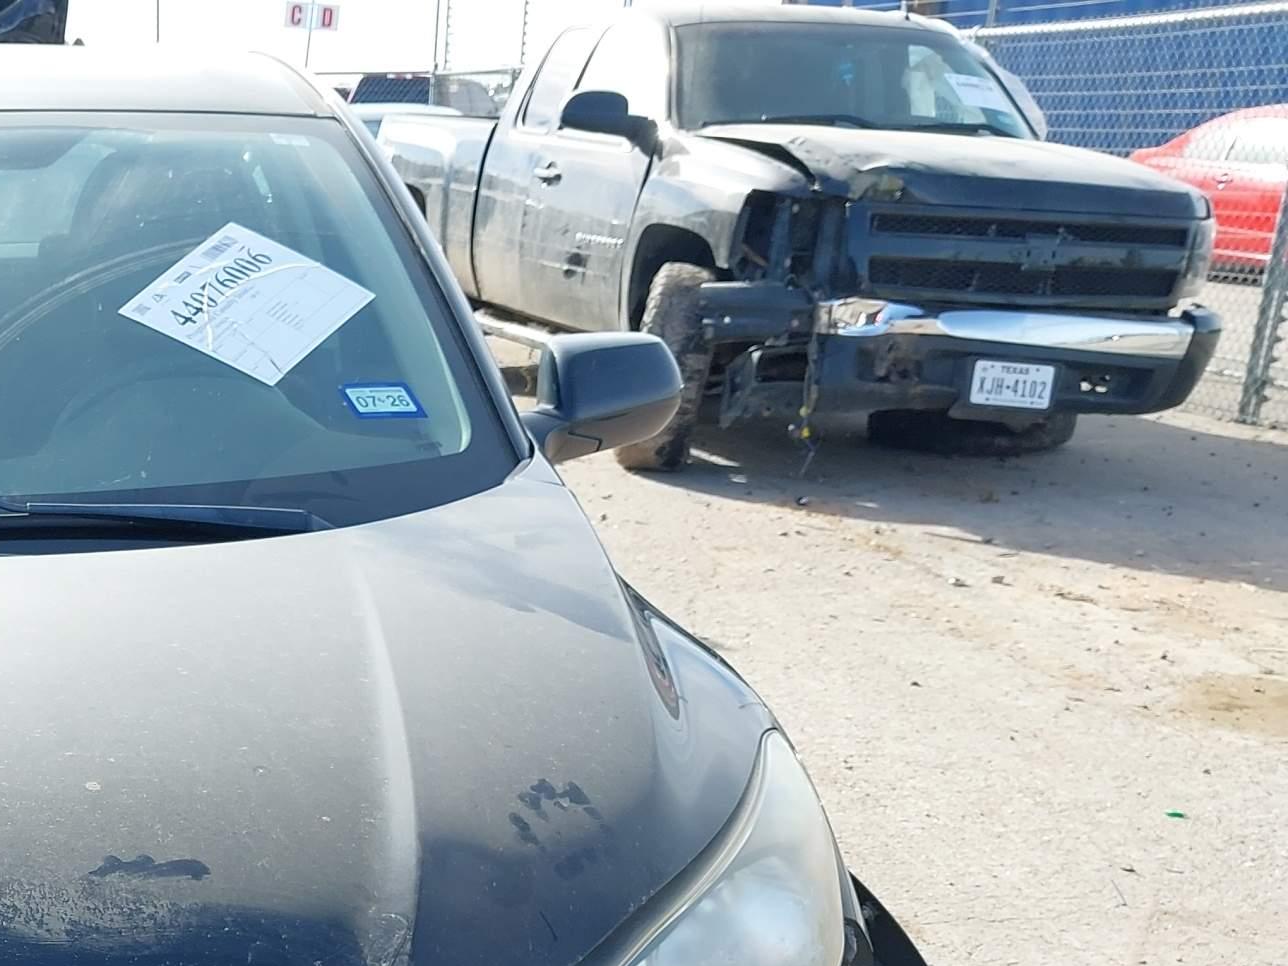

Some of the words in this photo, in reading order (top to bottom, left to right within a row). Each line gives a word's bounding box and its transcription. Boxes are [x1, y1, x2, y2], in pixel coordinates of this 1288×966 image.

[291, 5, 302, 26] C
[322, 7, 333, 28] D
[171, 248, 272, 326] 44076006
